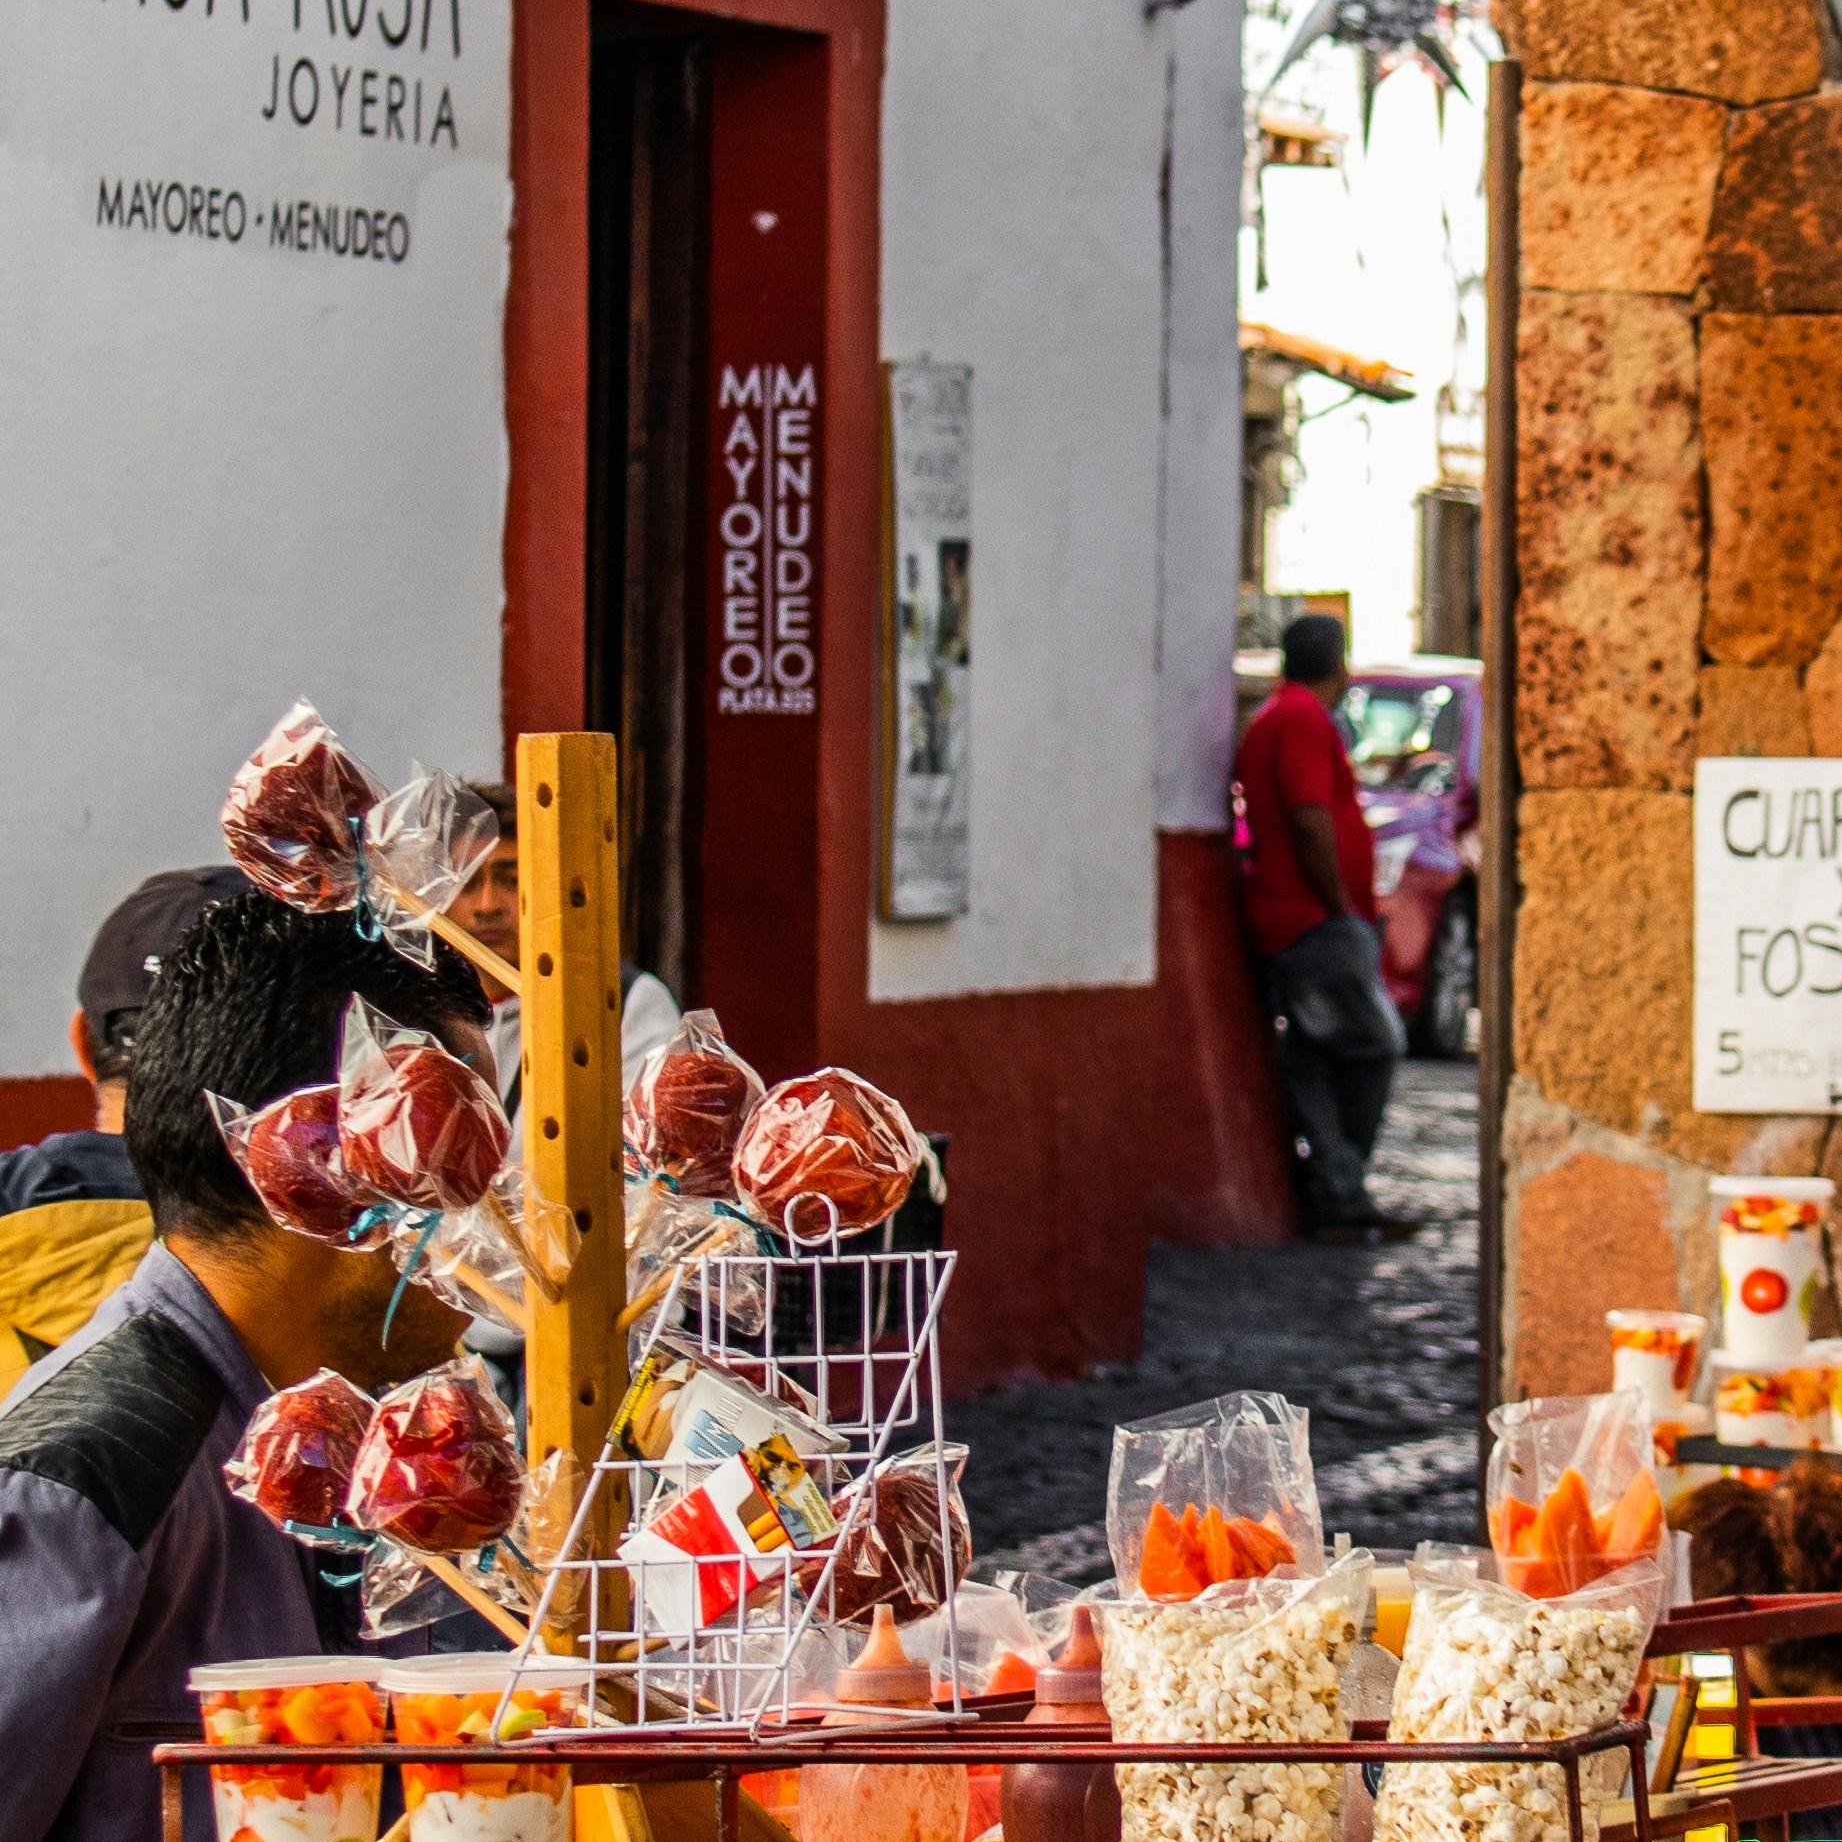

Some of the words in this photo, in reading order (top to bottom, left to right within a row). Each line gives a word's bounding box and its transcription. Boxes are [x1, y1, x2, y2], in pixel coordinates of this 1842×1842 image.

[261, 52, 458, 150] JOYERIA
[96, 177, 247, 244] MAYOREO
[269, 201, 410, 265] MENUDEO
[719, 363, 763, 689] MAYOREO
[772, 363, 817, 689] MENUDEO
[1715, 1030, 1744, 1076] 5
